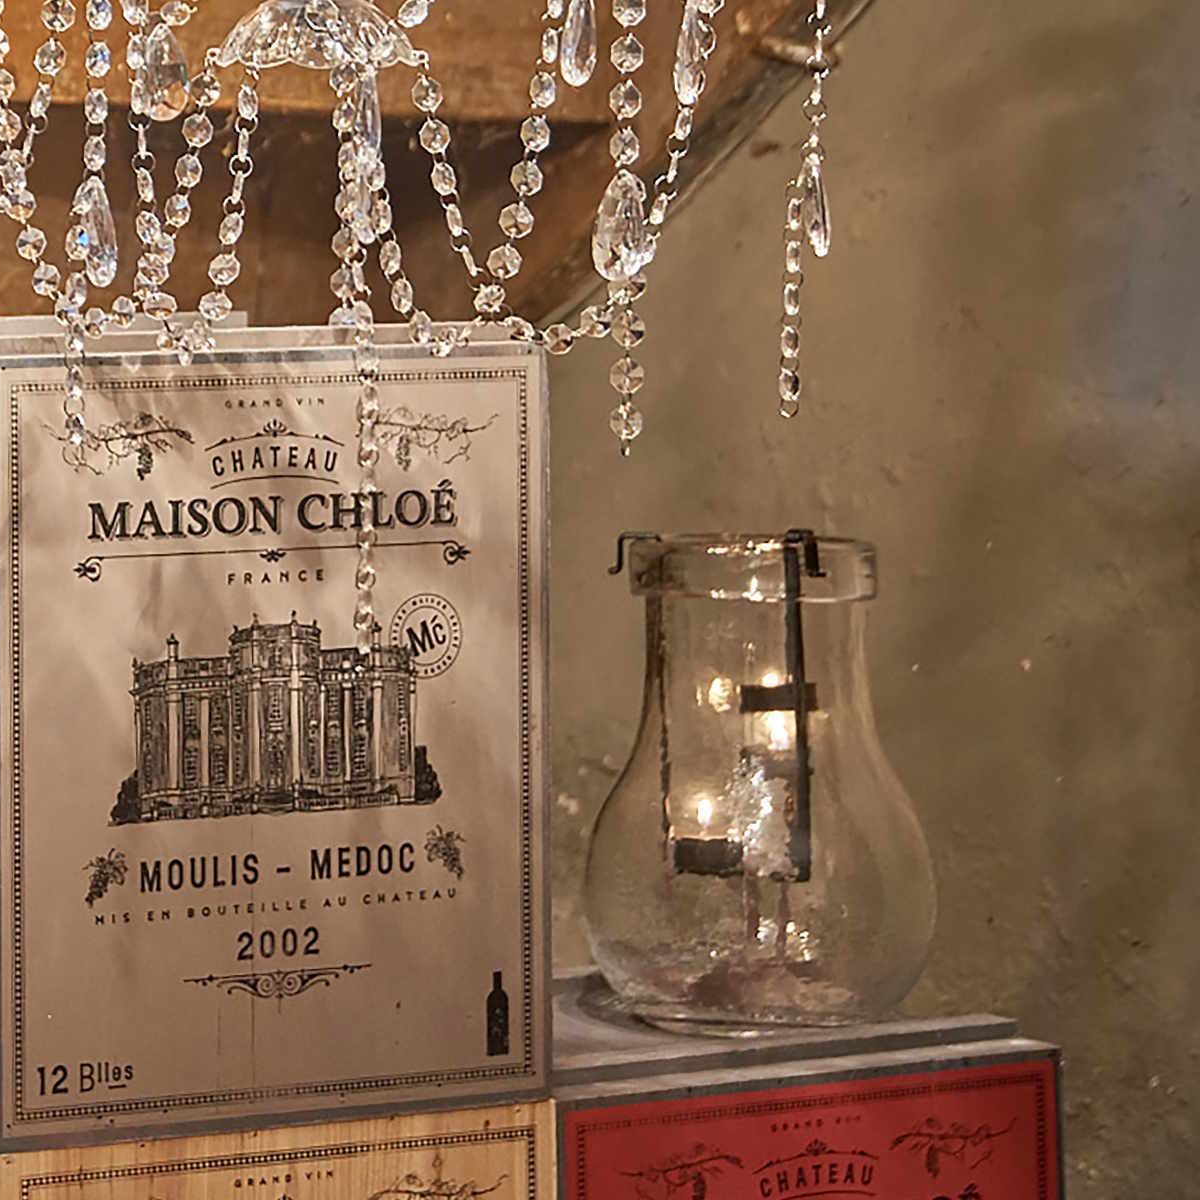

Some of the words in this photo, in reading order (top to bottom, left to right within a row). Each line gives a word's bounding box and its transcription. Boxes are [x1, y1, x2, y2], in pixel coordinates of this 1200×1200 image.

[225, 398, 283, 408] GRAND
[296, 397, 324, 405] VIN
[212, 446, 337, 476] CHATEAU
[88, 496, 284, 541] MAISON
[297, 479, 457, 532] CHLOÉ
[227, 569, 324, 586] FRANCE
[140, 854, 259, 892] MOULIS
[311, 843, 415, 880] MEDOC
[95, 912, 130, 925] MIS
[147, 909, 170, 921] EN
[188, 900, 307, 918] BOUTEILLE
[323, 895, 347, 907] AU
[363, 888, 457, 905] CHATEAU
[237, 927, 320, 961] 2002
[37, 1065, 68, 1095] 12
[234, 1174, 292, 1188] GRAND
[305, 1169, 333, 1180] VIN
[759, 1162, 874, 1198] CHATEAU
